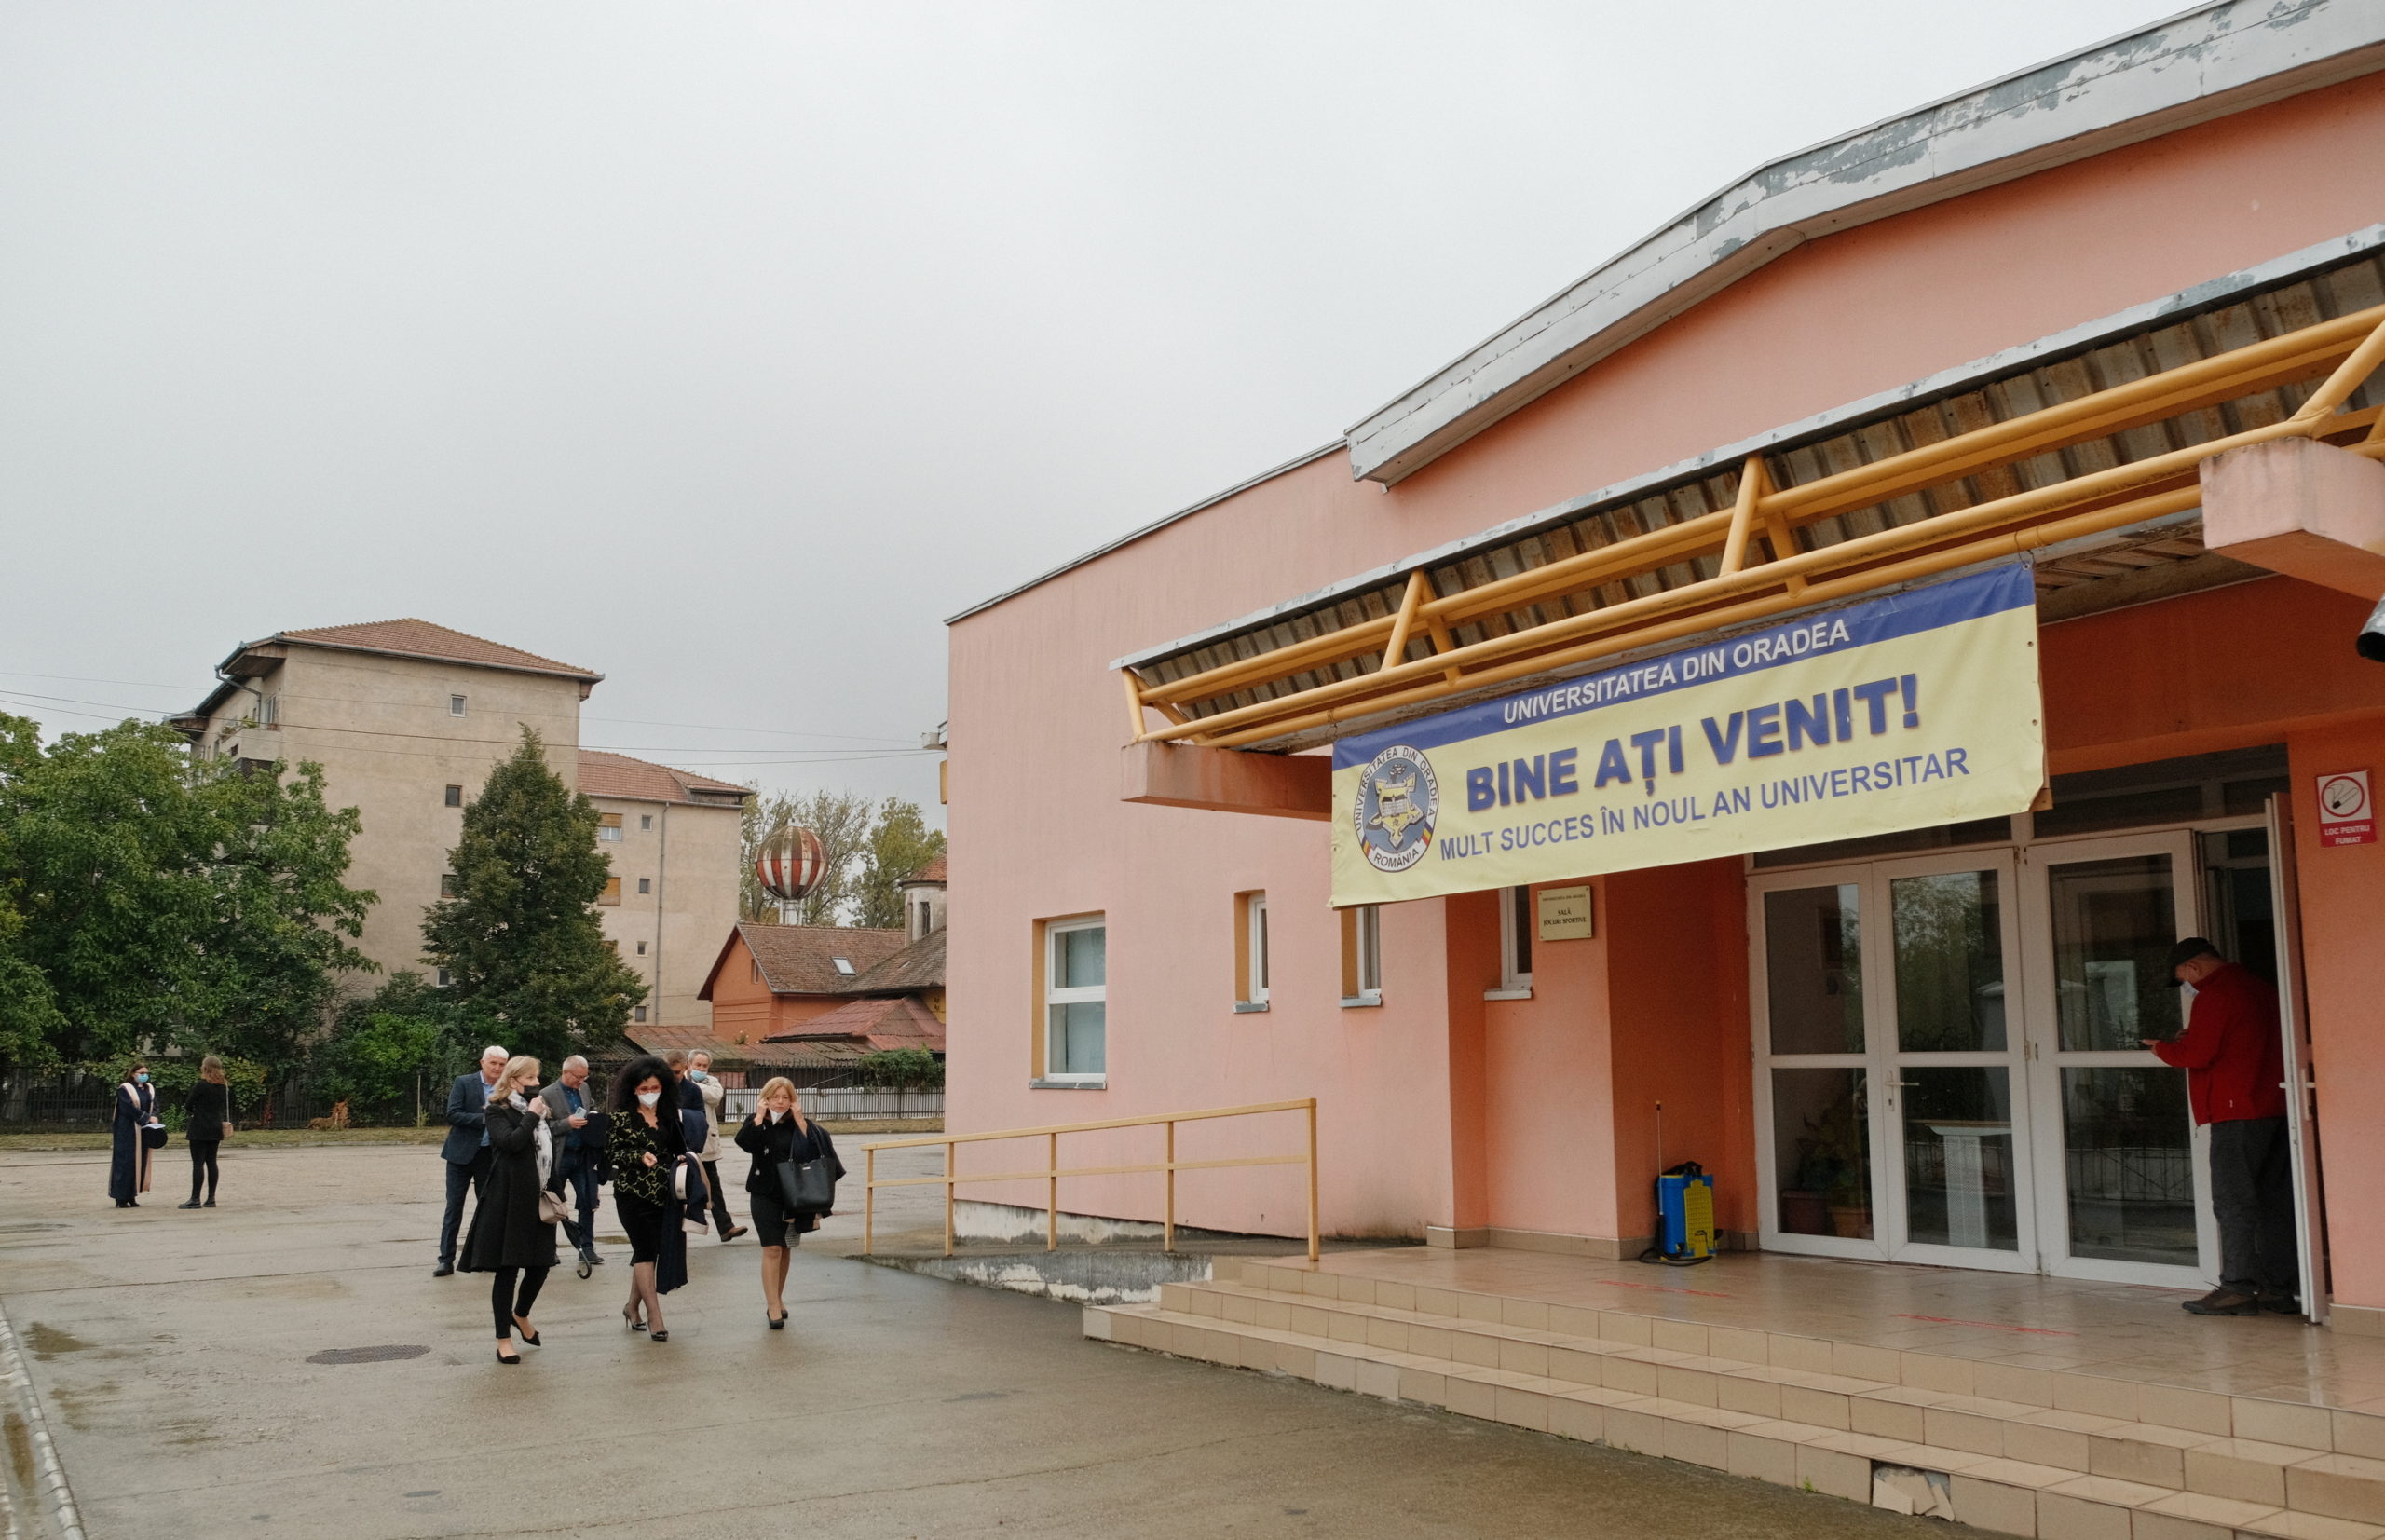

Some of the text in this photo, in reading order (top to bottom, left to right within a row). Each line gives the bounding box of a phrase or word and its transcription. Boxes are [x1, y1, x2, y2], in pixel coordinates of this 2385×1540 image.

[1504, 619, 1850, 724] UNIVERSITATEA DIN ORADEA
[1466, 673, 1919, 812] BINE AȚI VENIT!
[1355, 747, 1437, 831] UNIVERSITATEA DIN ORADEA
[1440, 747, 1970, 861] MULT SUCCES ÎN NOUL AN UNIVERSITAR
[2324, 825, 2370, 836] LOC PENTRU
[1374, 848, 1419, 868] ROMÂNIA
[2335, 836, 2361, 845] FUMAT
